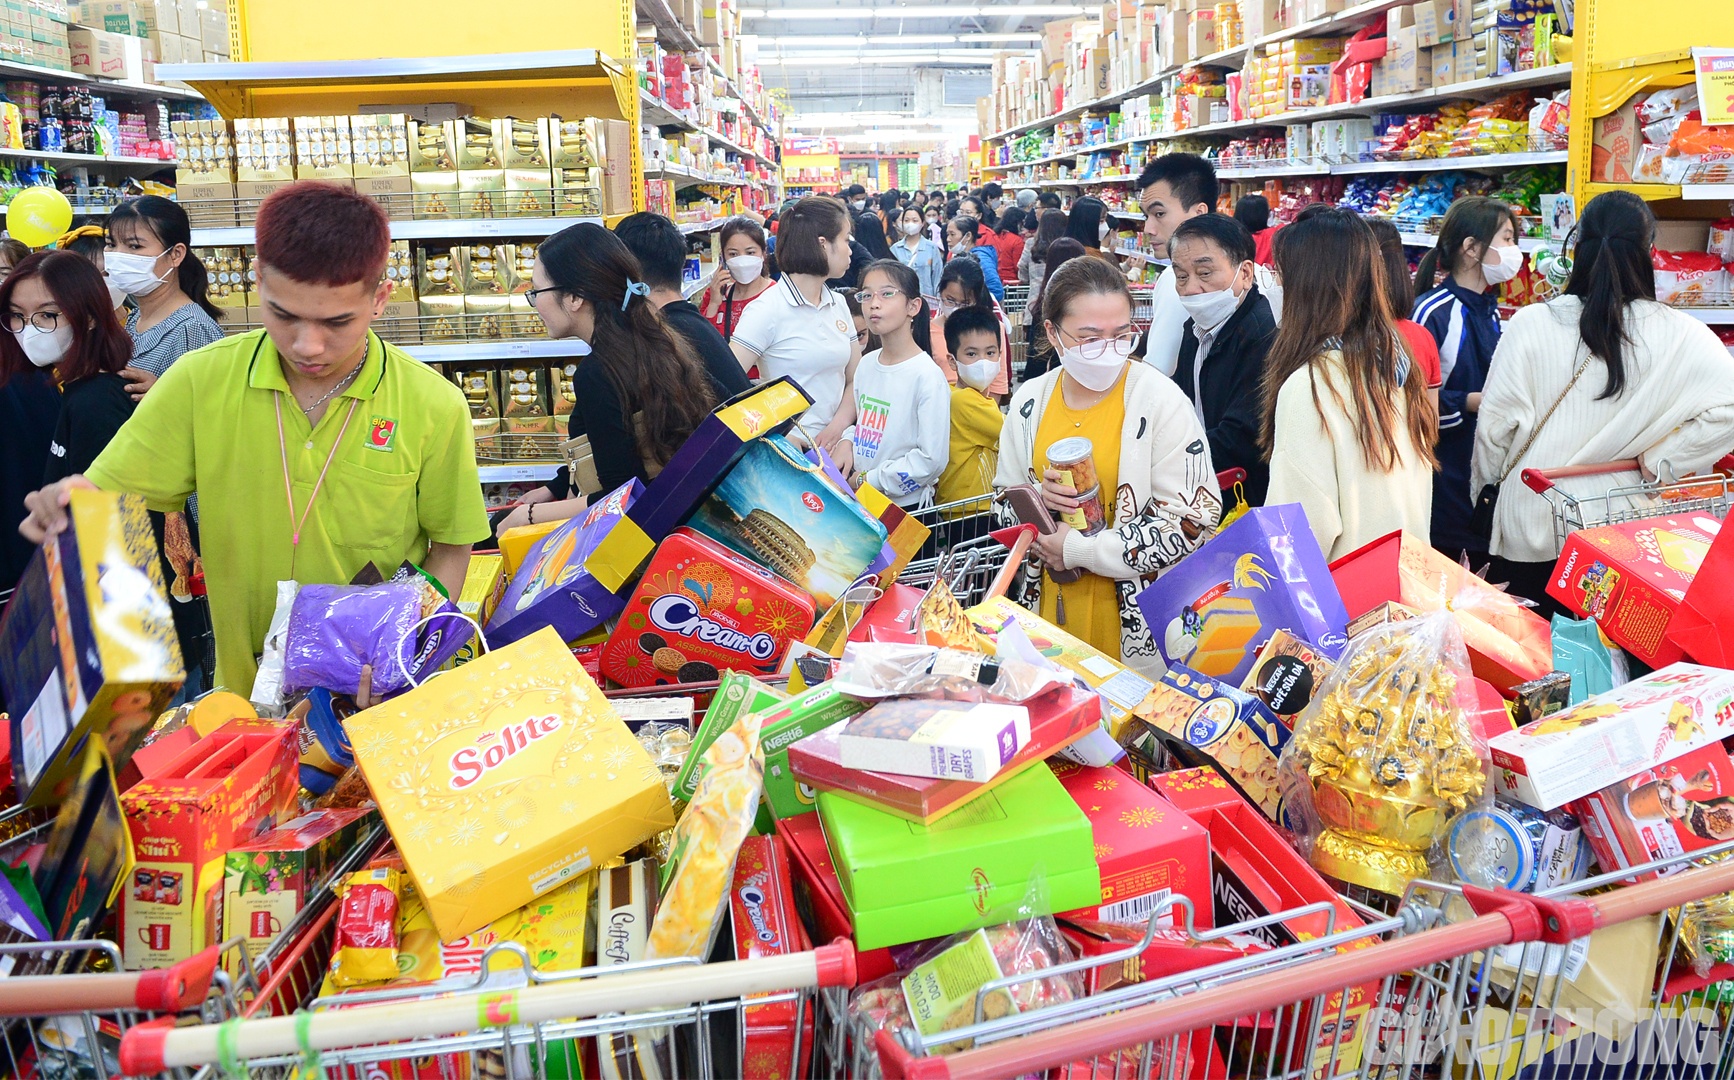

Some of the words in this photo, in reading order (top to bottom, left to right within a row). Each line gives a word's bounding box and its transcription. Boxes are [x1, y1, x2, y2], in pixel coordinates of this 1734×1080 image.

[1700, 151, 1732, 163] Karo
[1676, 270, 1705, 282] Karo
[803, 495, 823, 512] APEX
[1562, 549, 1579, 580] ORION
[648, 593, 776, 660] Cream-O
[674, 640, 742, 666] ASSORTMENT
[970, 662, 979, 678] RAW
[804, 690, 830, 706] MILO
[1270, 686, 1287, 711] CAFÉ
[710, 714, 726, 737] Whole
[719, 700, 732, 721] Grain
[820, 706, 842, 722] Whole
[450, 713, 561, 789] Solite
[937, 746, 947, 777] PREMIUM
[949, 752, 963, 773] DRY
[1069, 748, 1086, 764] Facts
[962, 749, 974, 780] GRAPES
[1504, 774, 1518, 790] AFC
[527, 854, 573, 883] RECYCLE
[572, 845, 589, 859] ME
